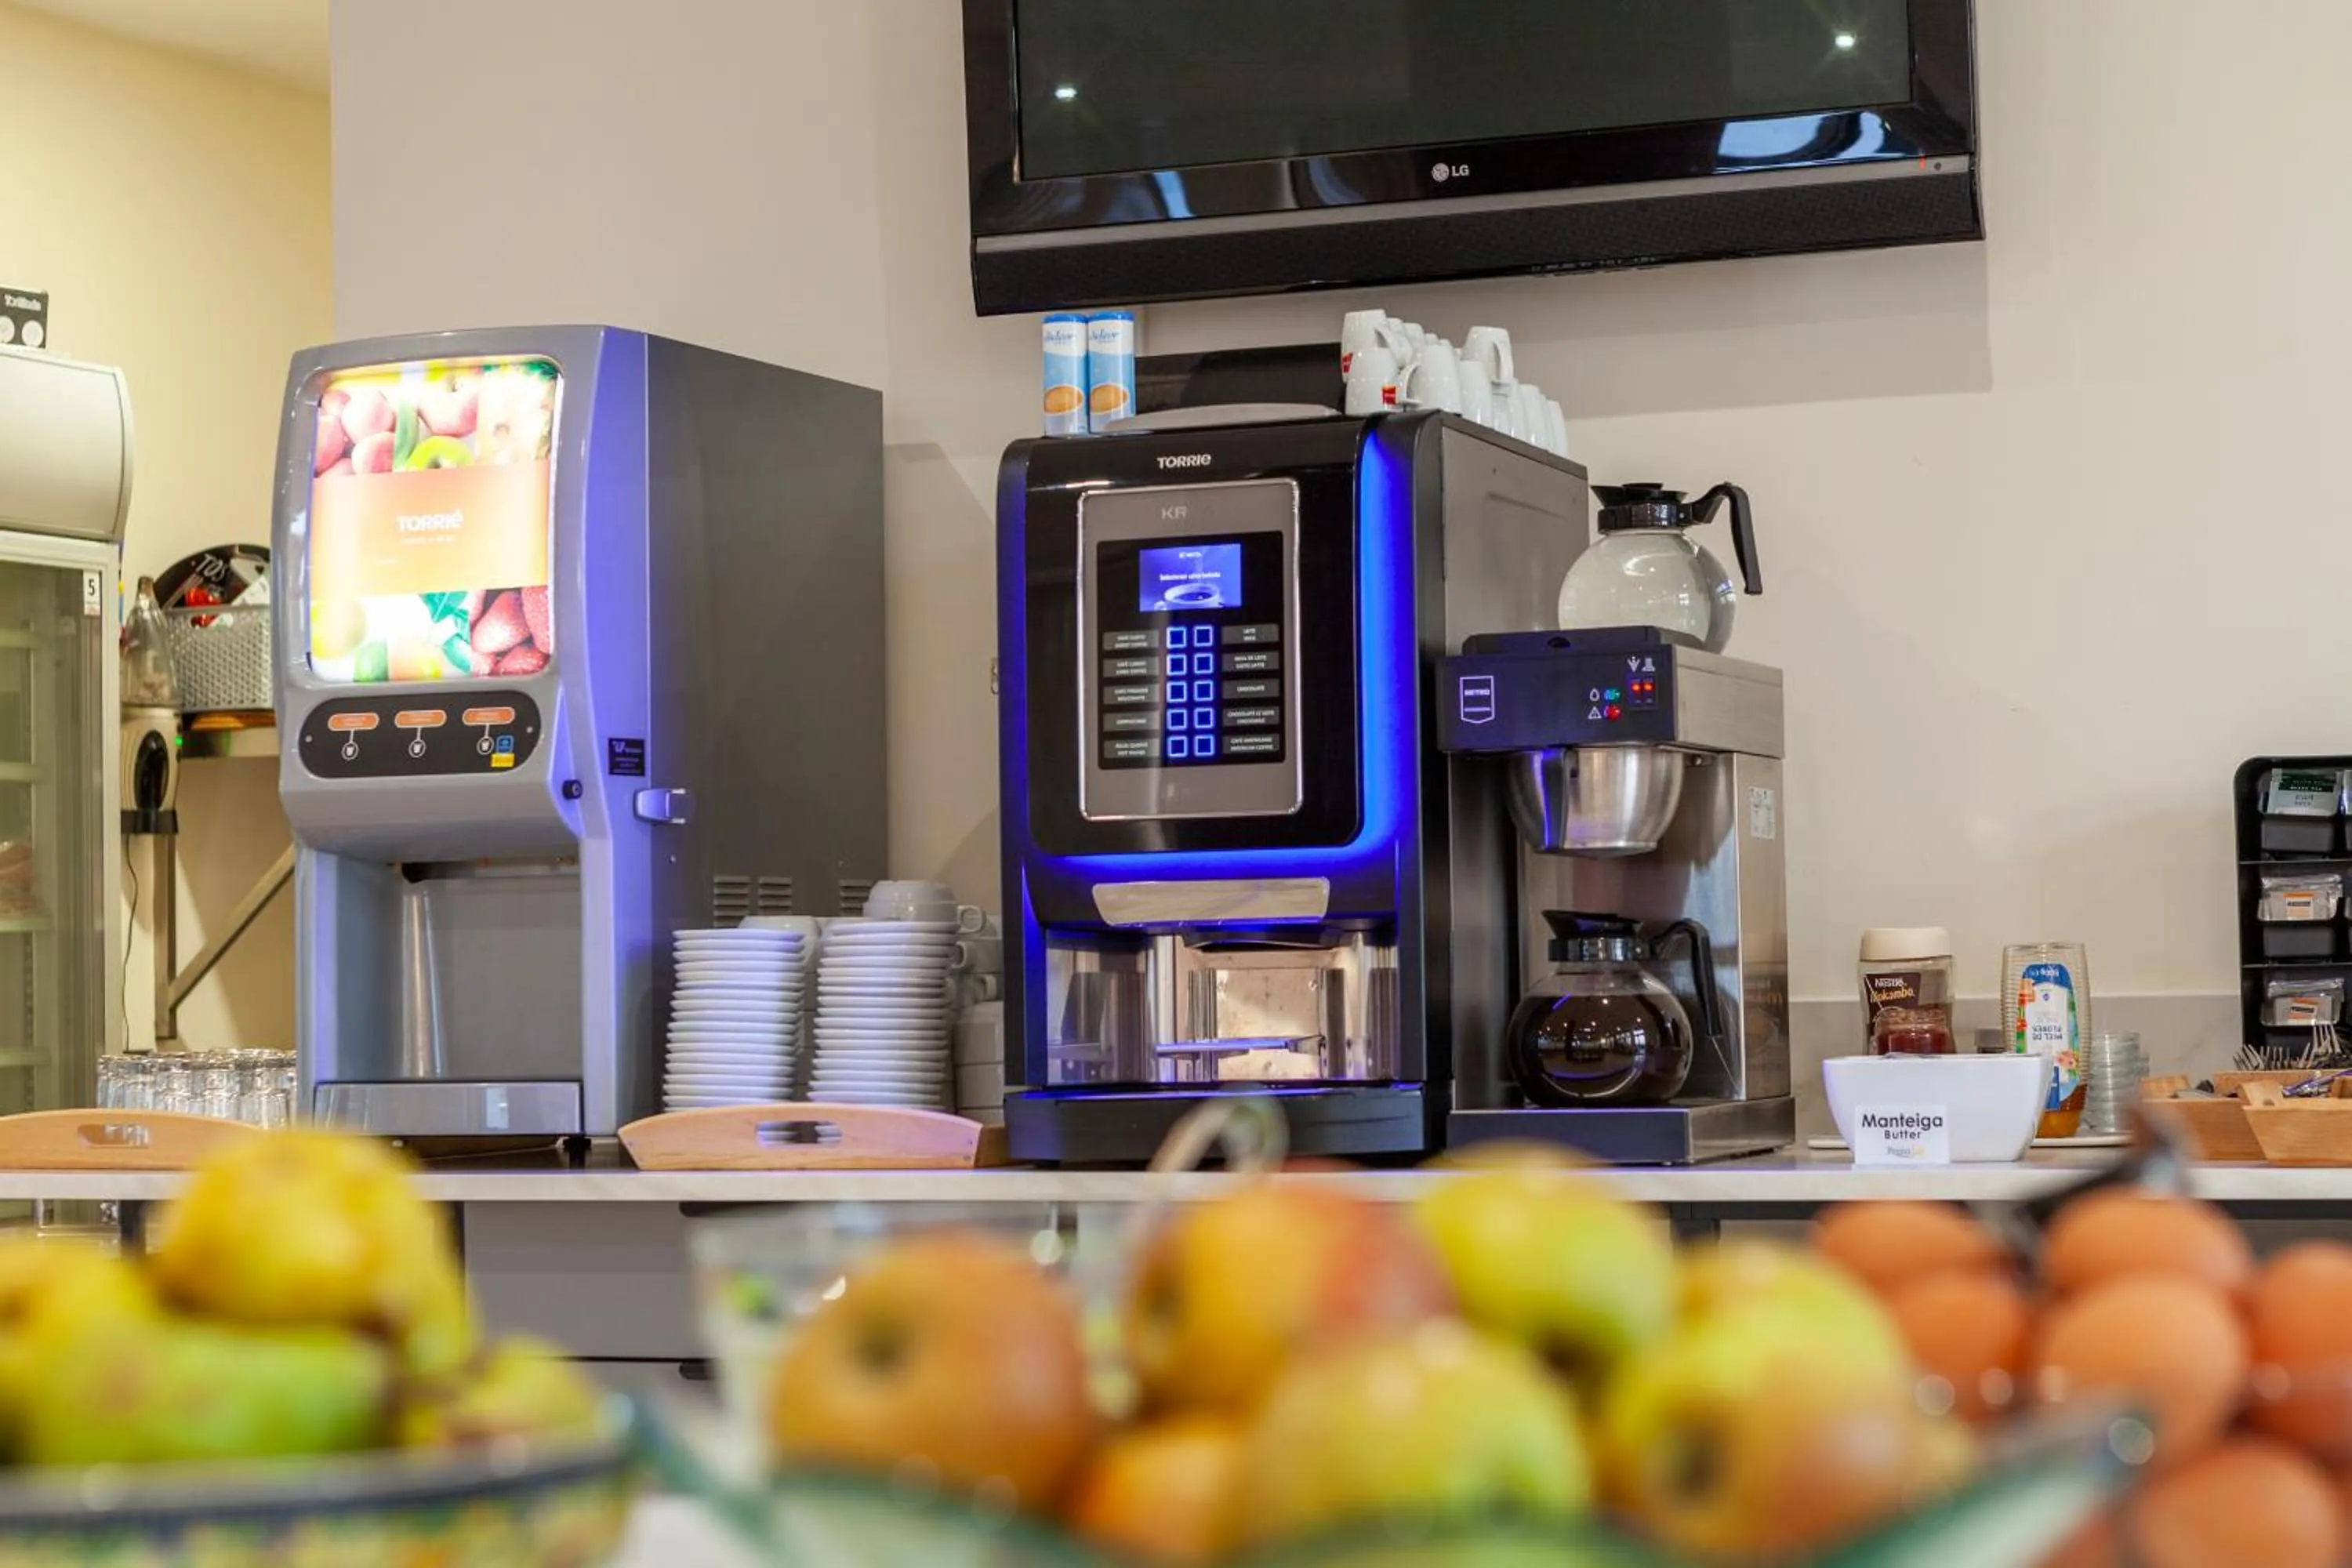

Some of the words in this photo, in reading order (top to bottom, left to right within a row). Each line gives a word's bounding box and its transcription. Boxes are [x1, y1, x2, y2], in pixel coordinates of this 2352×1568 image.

[1451, 164, 1470, 177] LG
[88, 578, 96, 596] 5
[1862, 1112, 1944, 1131] Manteiga
[1883, 1129, 1921, 1140] Butter
